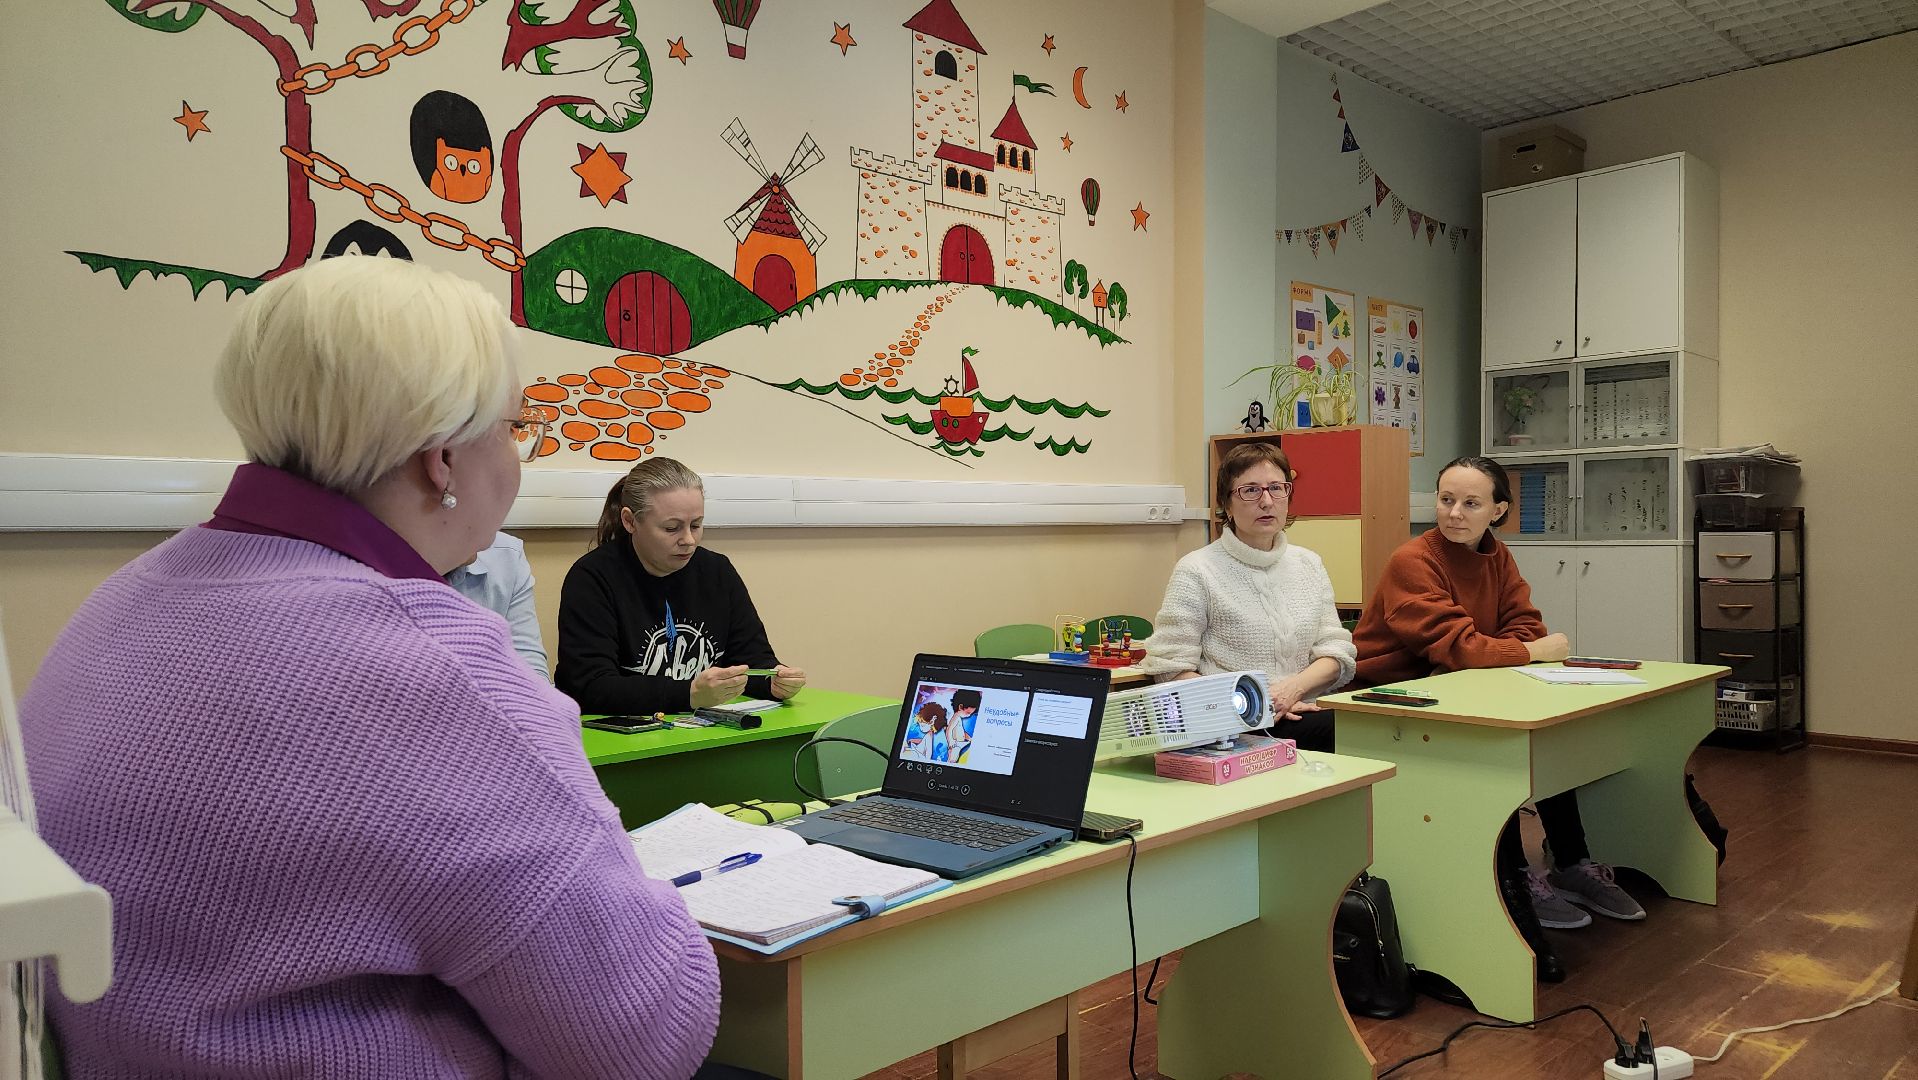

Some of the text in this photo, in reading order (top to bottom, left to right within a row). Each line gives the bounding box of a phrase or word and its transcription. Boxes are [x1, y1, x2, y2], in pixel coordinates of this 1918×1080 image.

[984, 707, 1019, 717] Неудобные
[1240, 752, 1260, 766] НАБОР
[1261, 748, 1277, 760] ЦИФР
[1251, 759, 1274, 773] ЗНАКОВ
